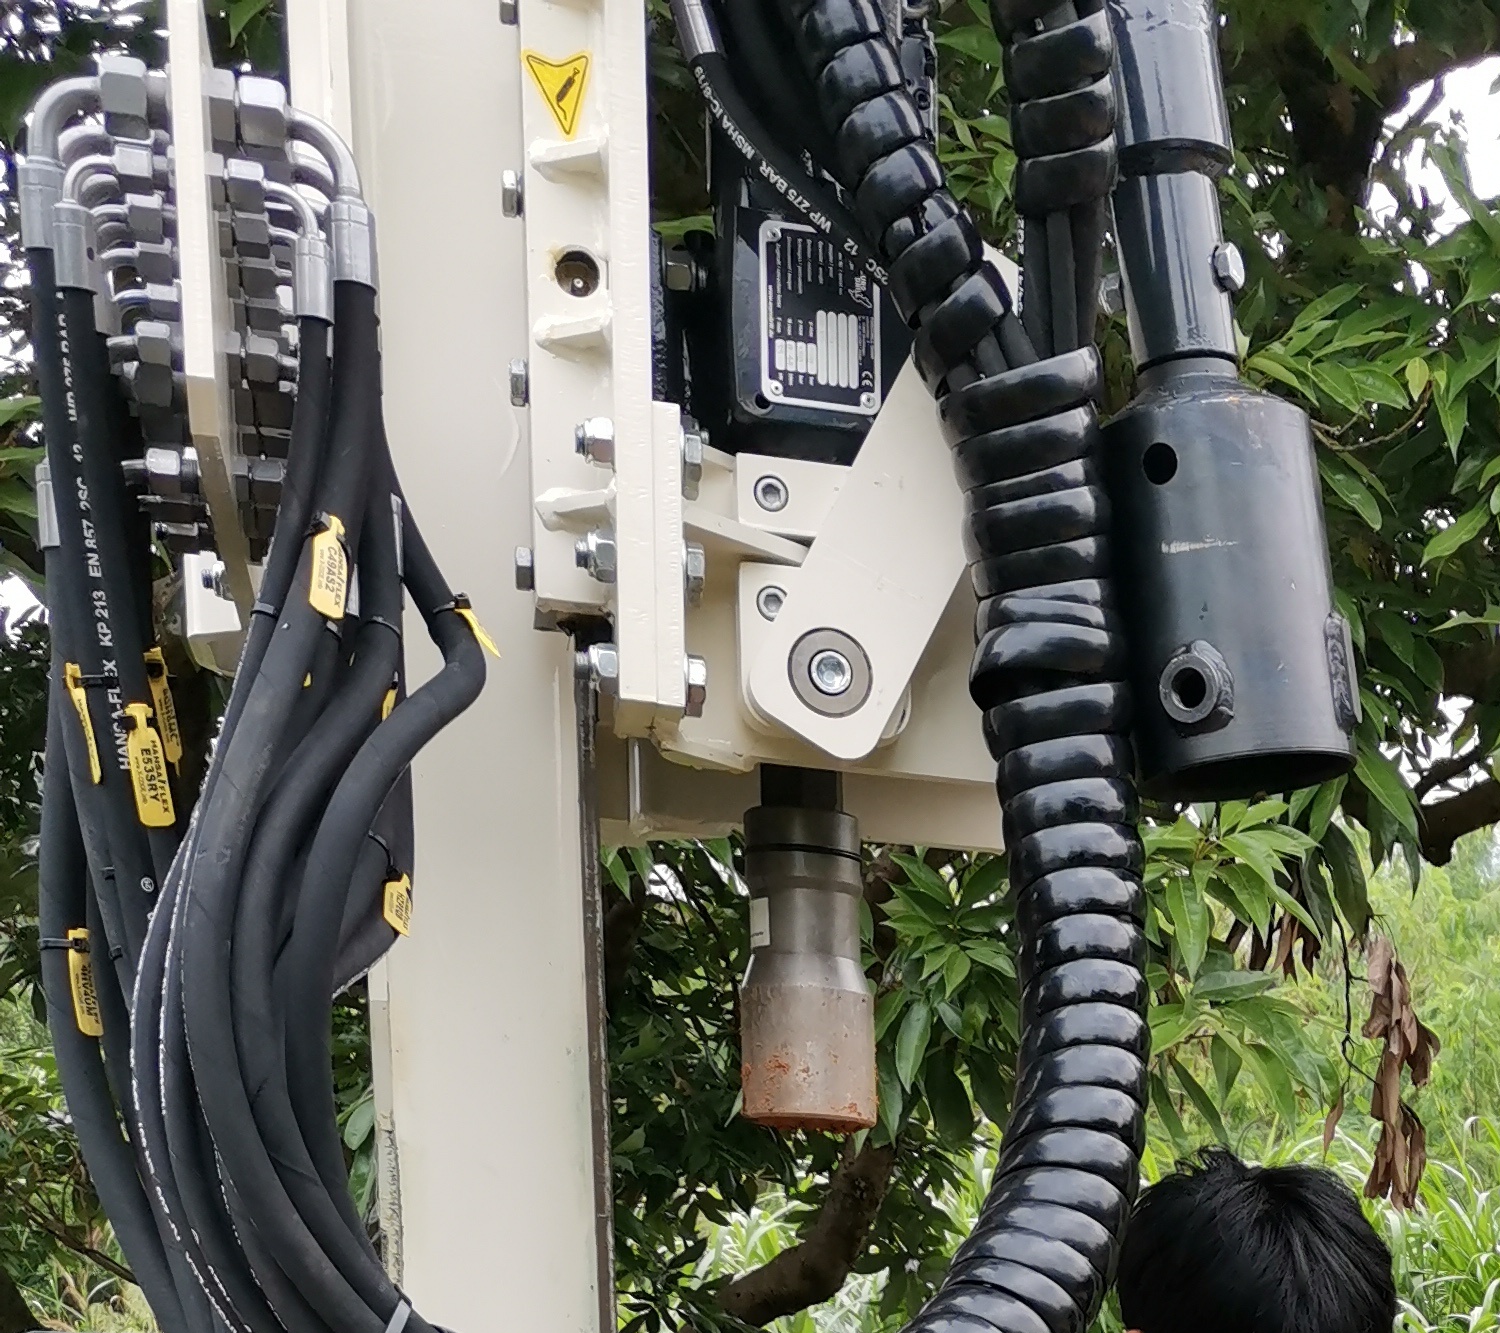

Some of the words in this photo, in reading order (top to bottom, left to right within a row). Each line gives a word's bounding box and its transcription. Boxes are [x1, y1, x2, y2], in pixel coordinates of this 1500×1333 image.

[722, 115, 756, 160] MSHA
[759, 160, 789, 194] BAR
[787, 188, 811, 213] 275
[809, 211, 832, 234] WP
[843, 238, 858, 256] 12
[81, 519, 98, 549] 857
[87, 552, 102, 578] EN
[92, 590, 110, 619] 213
[97, 622, 114, 647] KP
[103, 659, 131, 770] HANSA-FLX
[140, 747, 161, 802] E53SRY
